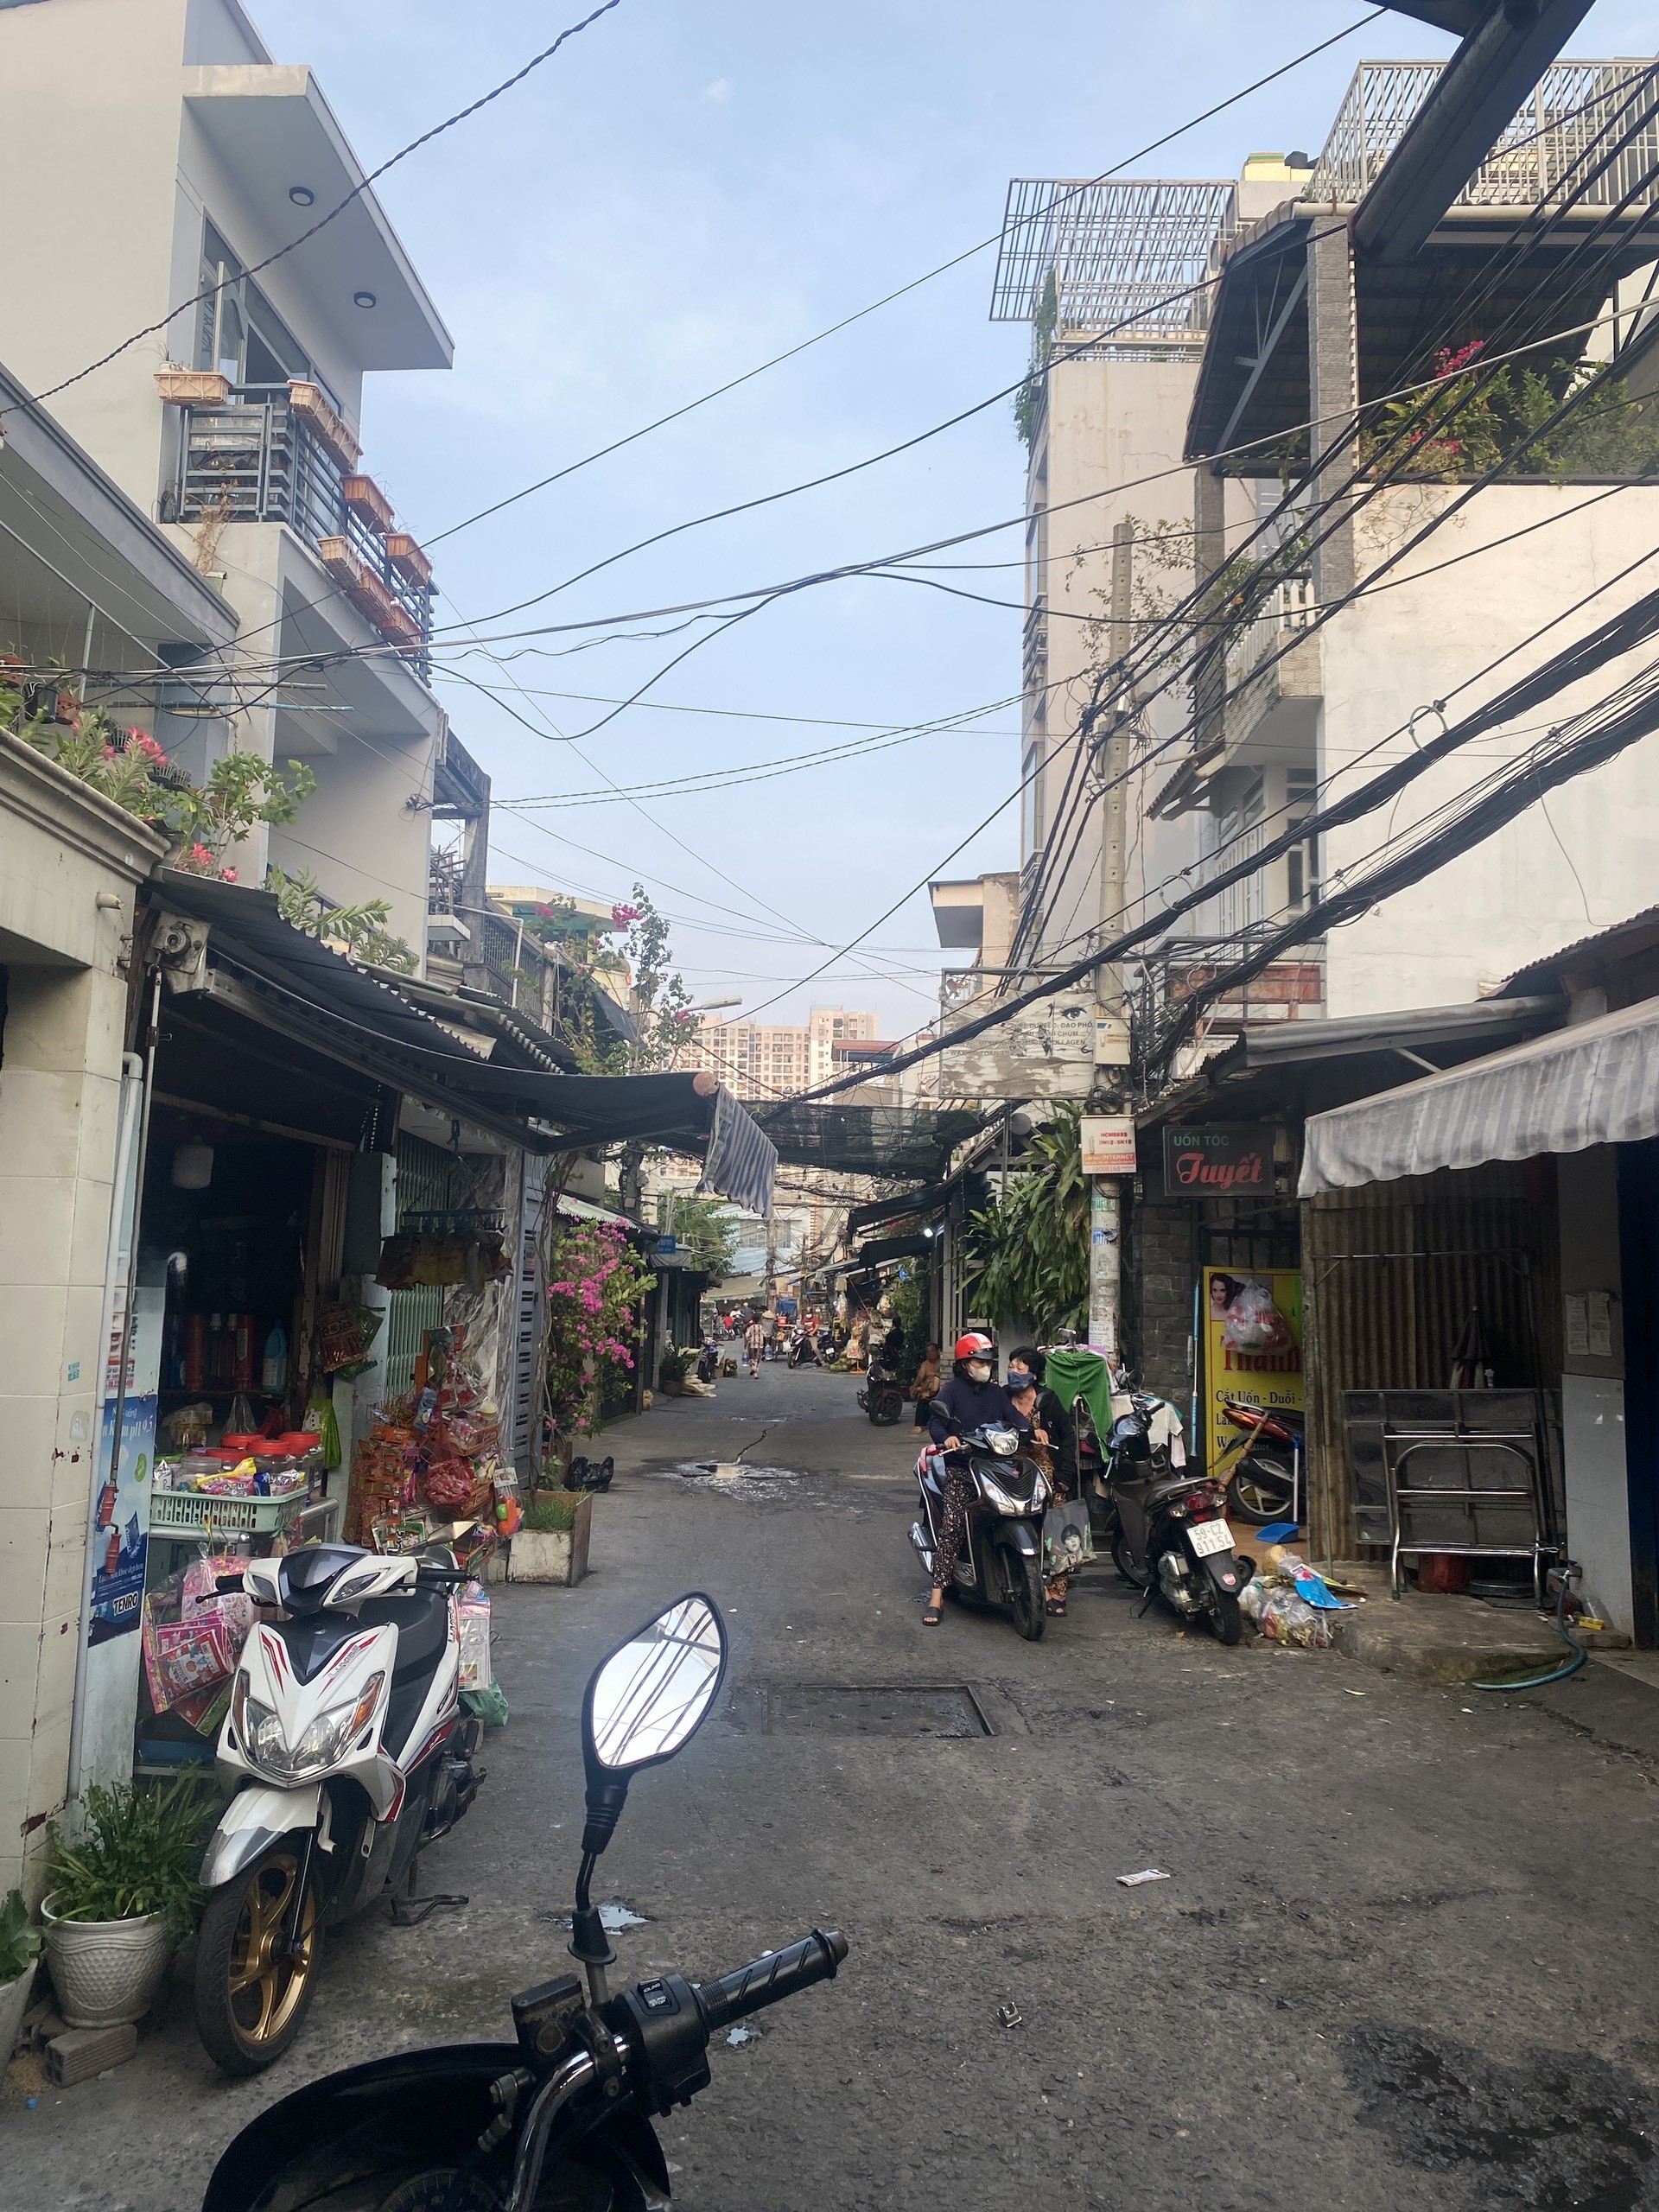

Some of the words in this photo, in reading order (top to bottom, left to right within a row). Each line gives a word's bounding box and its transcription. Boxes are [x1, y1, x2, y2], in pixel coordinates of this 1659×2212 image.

[1173, 1132, 1200, 1147] UỐN
[1204, 1133, 1230, 1146] TÓC
[1176, 1153, 1263, 1190] Tuyết
[1238, 1389, 1260, 1403] Uốn
[1194, 1523, 1224, 1541] 59-C2
[1197, 1535, 1232, 1554] 911.54
[113, 1592, 139, 1616] TENRO
